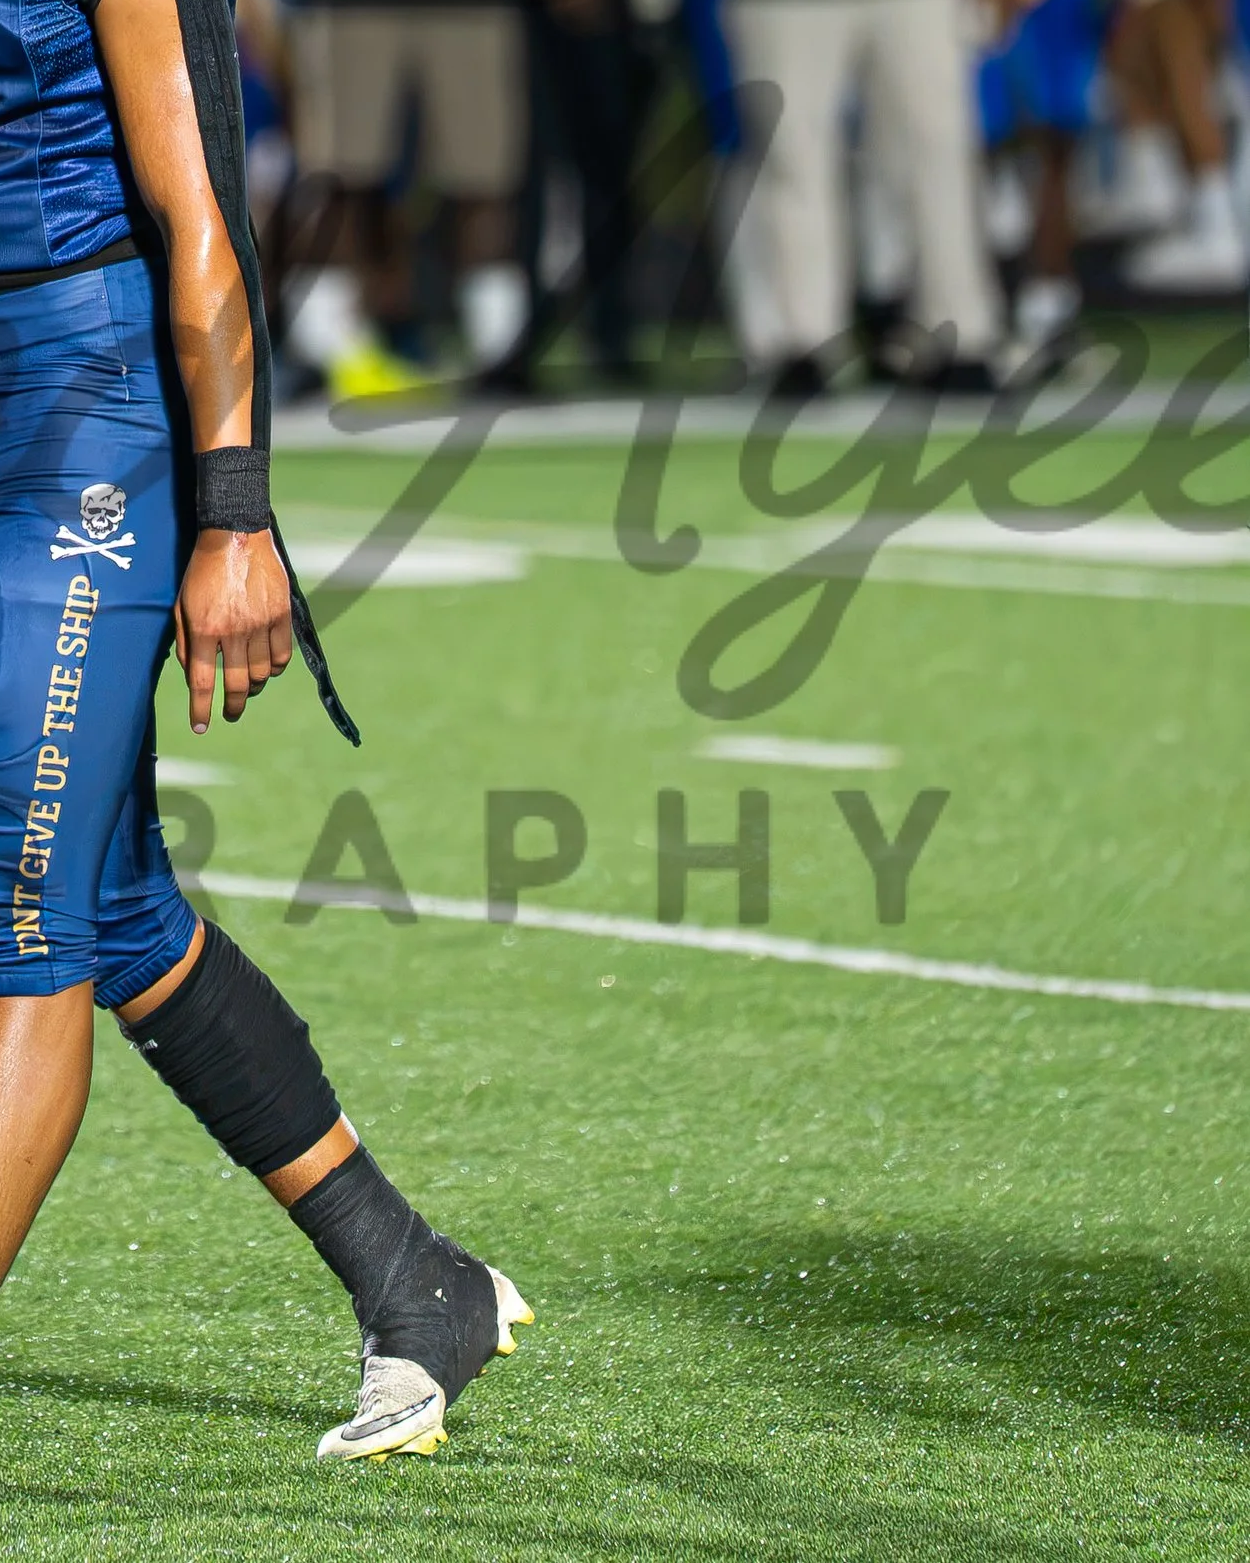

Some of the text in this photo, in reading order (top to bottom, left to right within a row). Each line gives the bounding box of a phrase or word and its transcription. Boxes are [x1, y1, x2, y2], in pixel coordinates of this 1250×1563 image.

[56, 574, 100, 658] SHIP
[43, 664, 82, 738] THE
[34, 744, 70, 791] UP
[19, 799, 62, 879] GIVE
